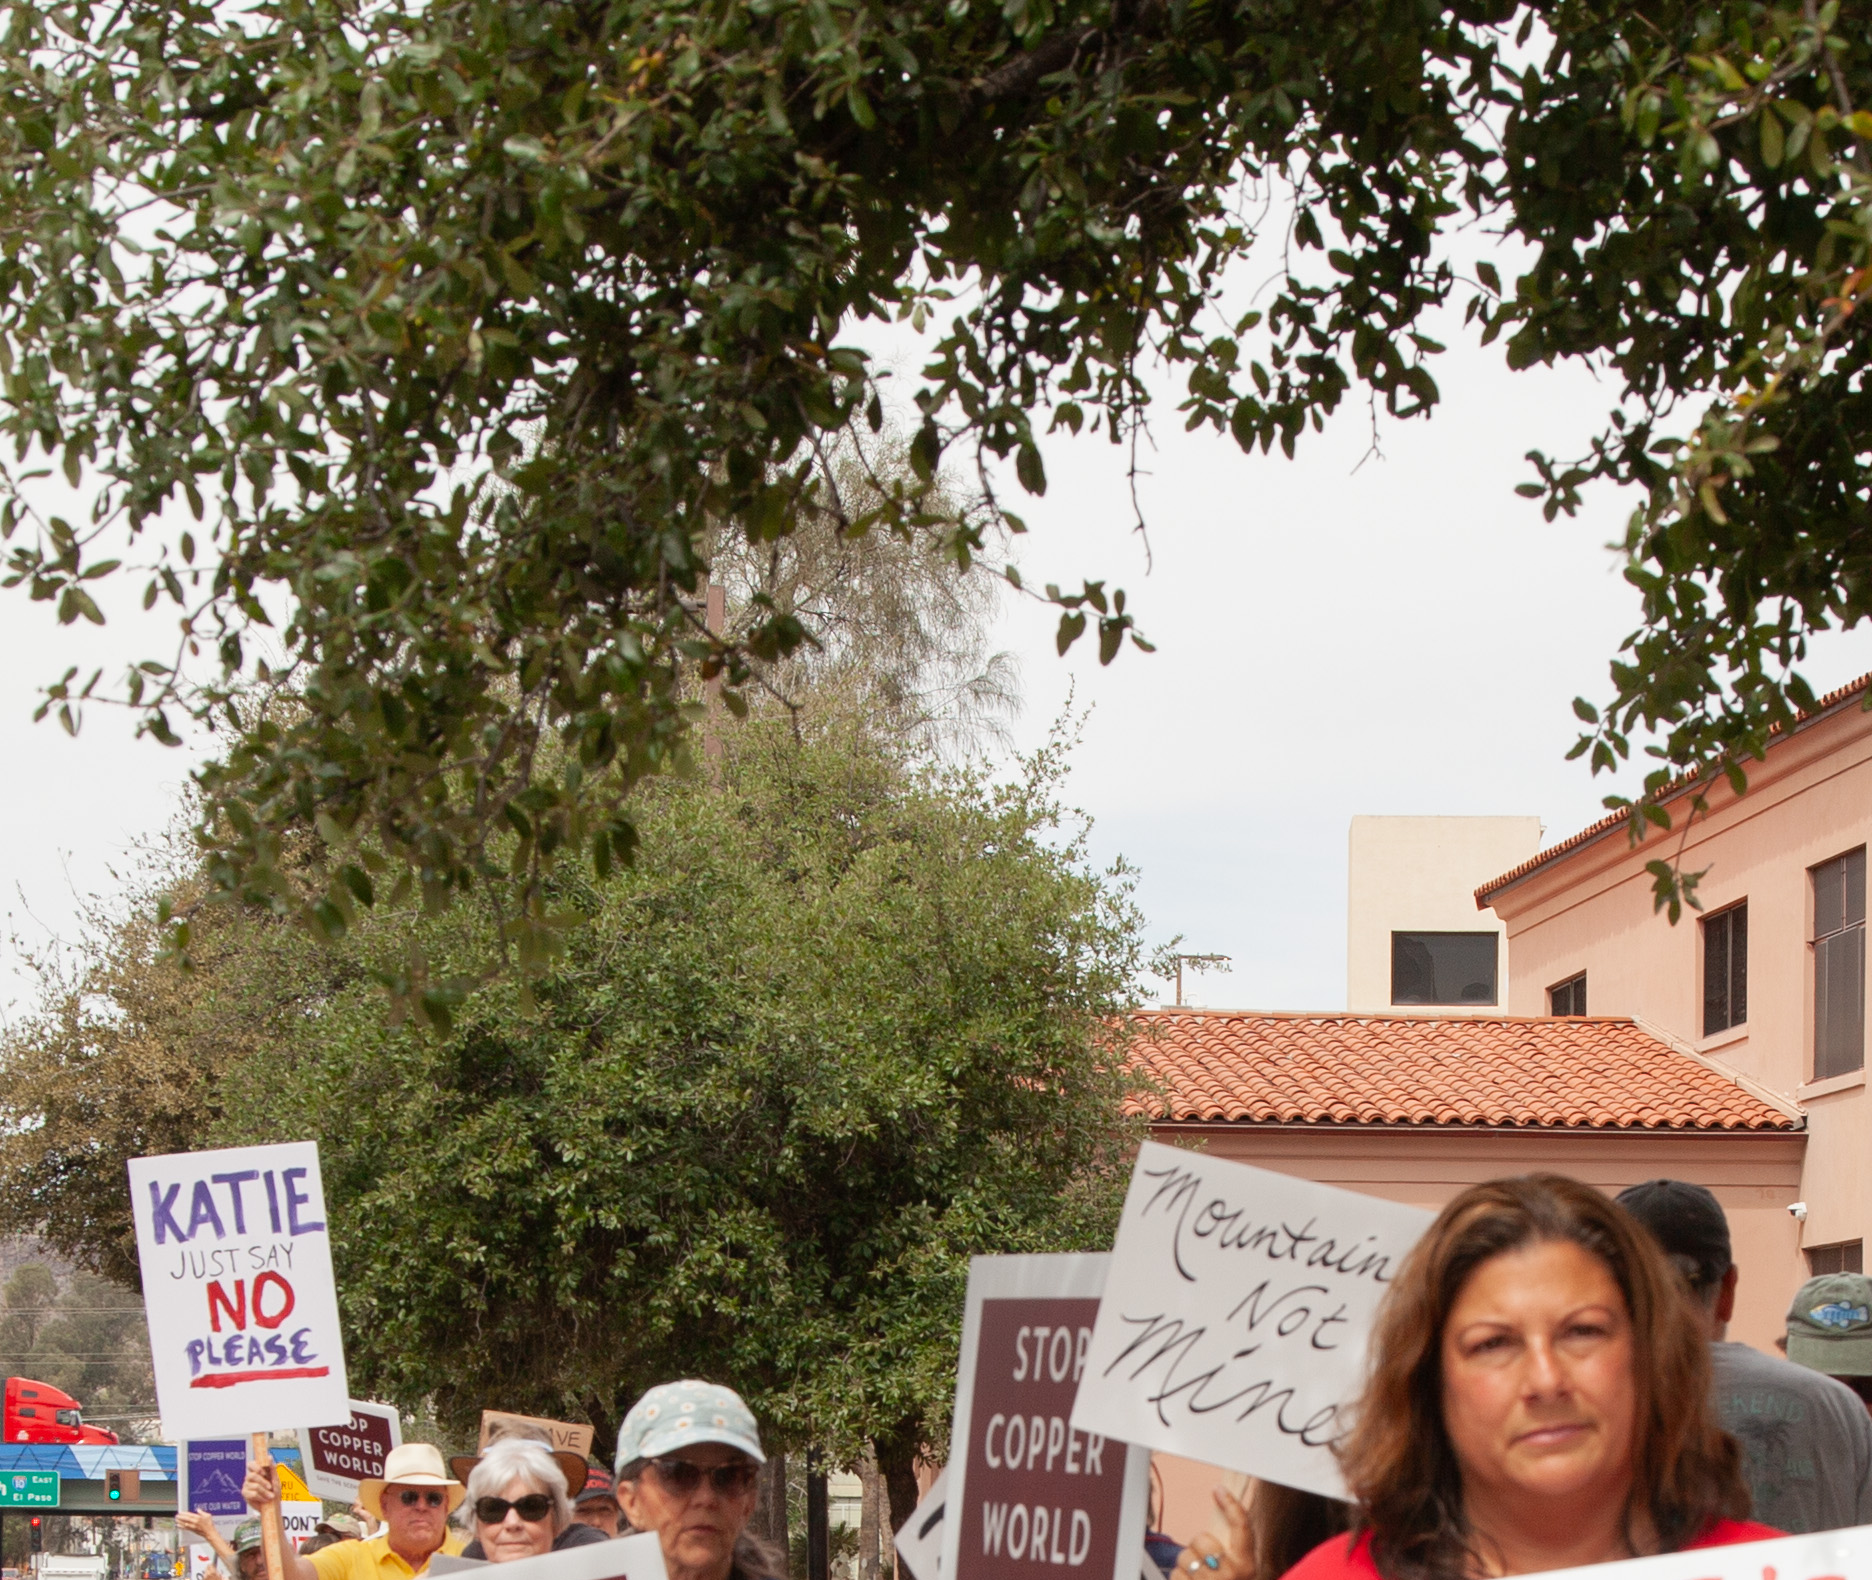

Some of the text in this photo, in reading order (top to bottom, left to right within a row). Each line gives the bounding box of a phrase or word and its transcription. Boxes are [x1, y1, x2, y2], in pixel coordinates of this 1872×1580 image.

[149, 1168, 325, 1244] KATIE
[1142, 1165, 1392, 1283] Mountain
[170, 1242, 294, 1279] JUST SAY
[207, 1270, 295, 1333] NO
[1227, 1280, 1349, 1350] Not
[184, 1328, 319, 1376] PLEASE
[1013, 1325, 1093, 1383] STOP
[318, 1429, 383, 1457] COPPER
[347, 1417, 368, 1433] OP
[985, 1412, 1106, 1476] COPPER
[323, 1450, 383, 1476] WORLD
[13, 1493, 52, 1501] El Paso
[282, 1515, 319, 1531] DON'T
[983, 1500, 1091, 1566] WORLD
